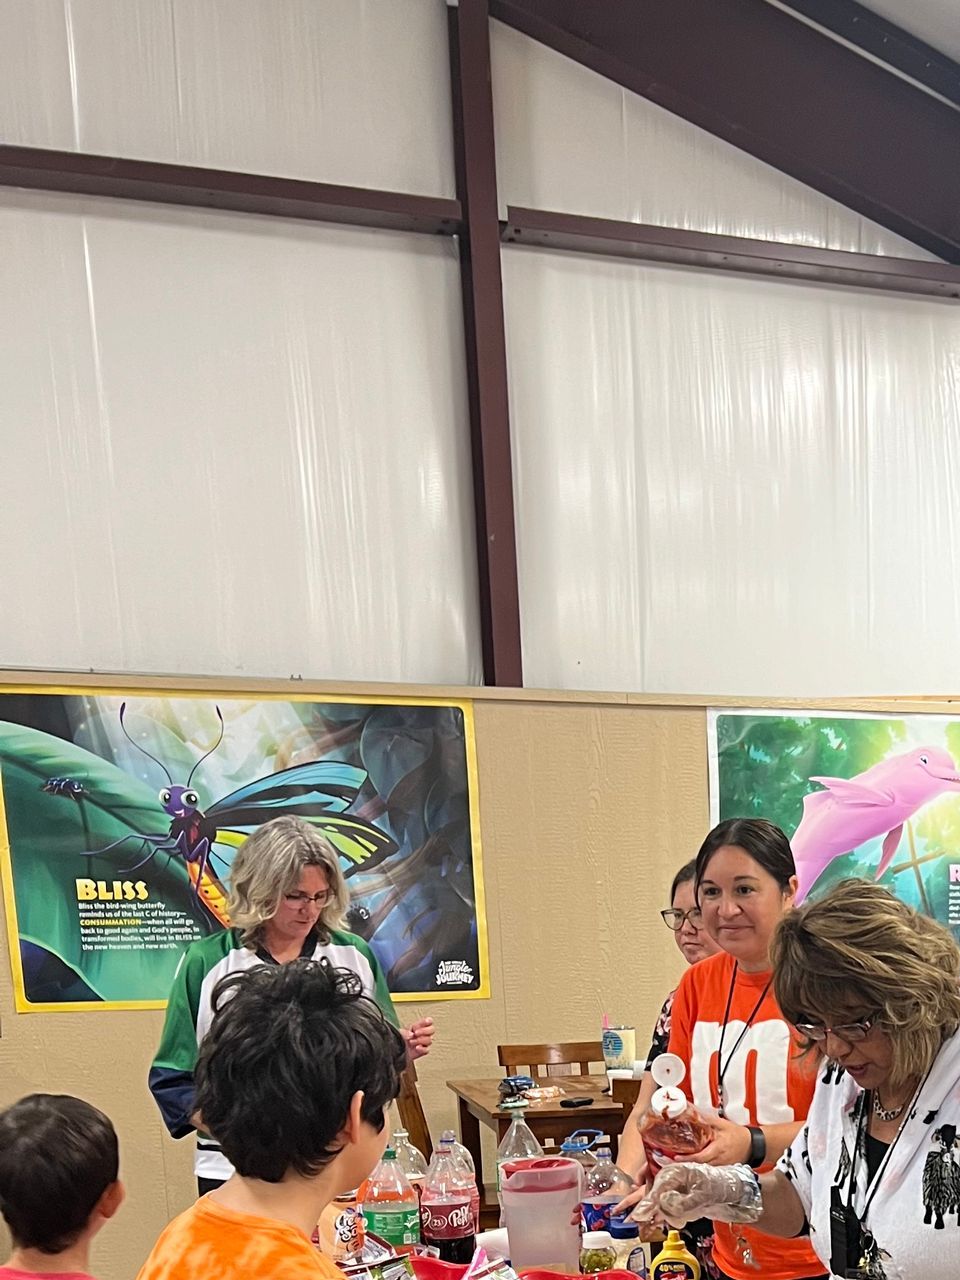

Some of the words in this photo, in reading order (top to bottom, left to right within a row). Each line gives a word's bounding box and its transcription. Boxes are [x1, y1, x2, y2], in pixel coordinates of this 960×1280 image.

[76, 879, 149, 900] BLISS
[137, 902, 165, 910] butterfly
[105, 927, 120, 935] good
